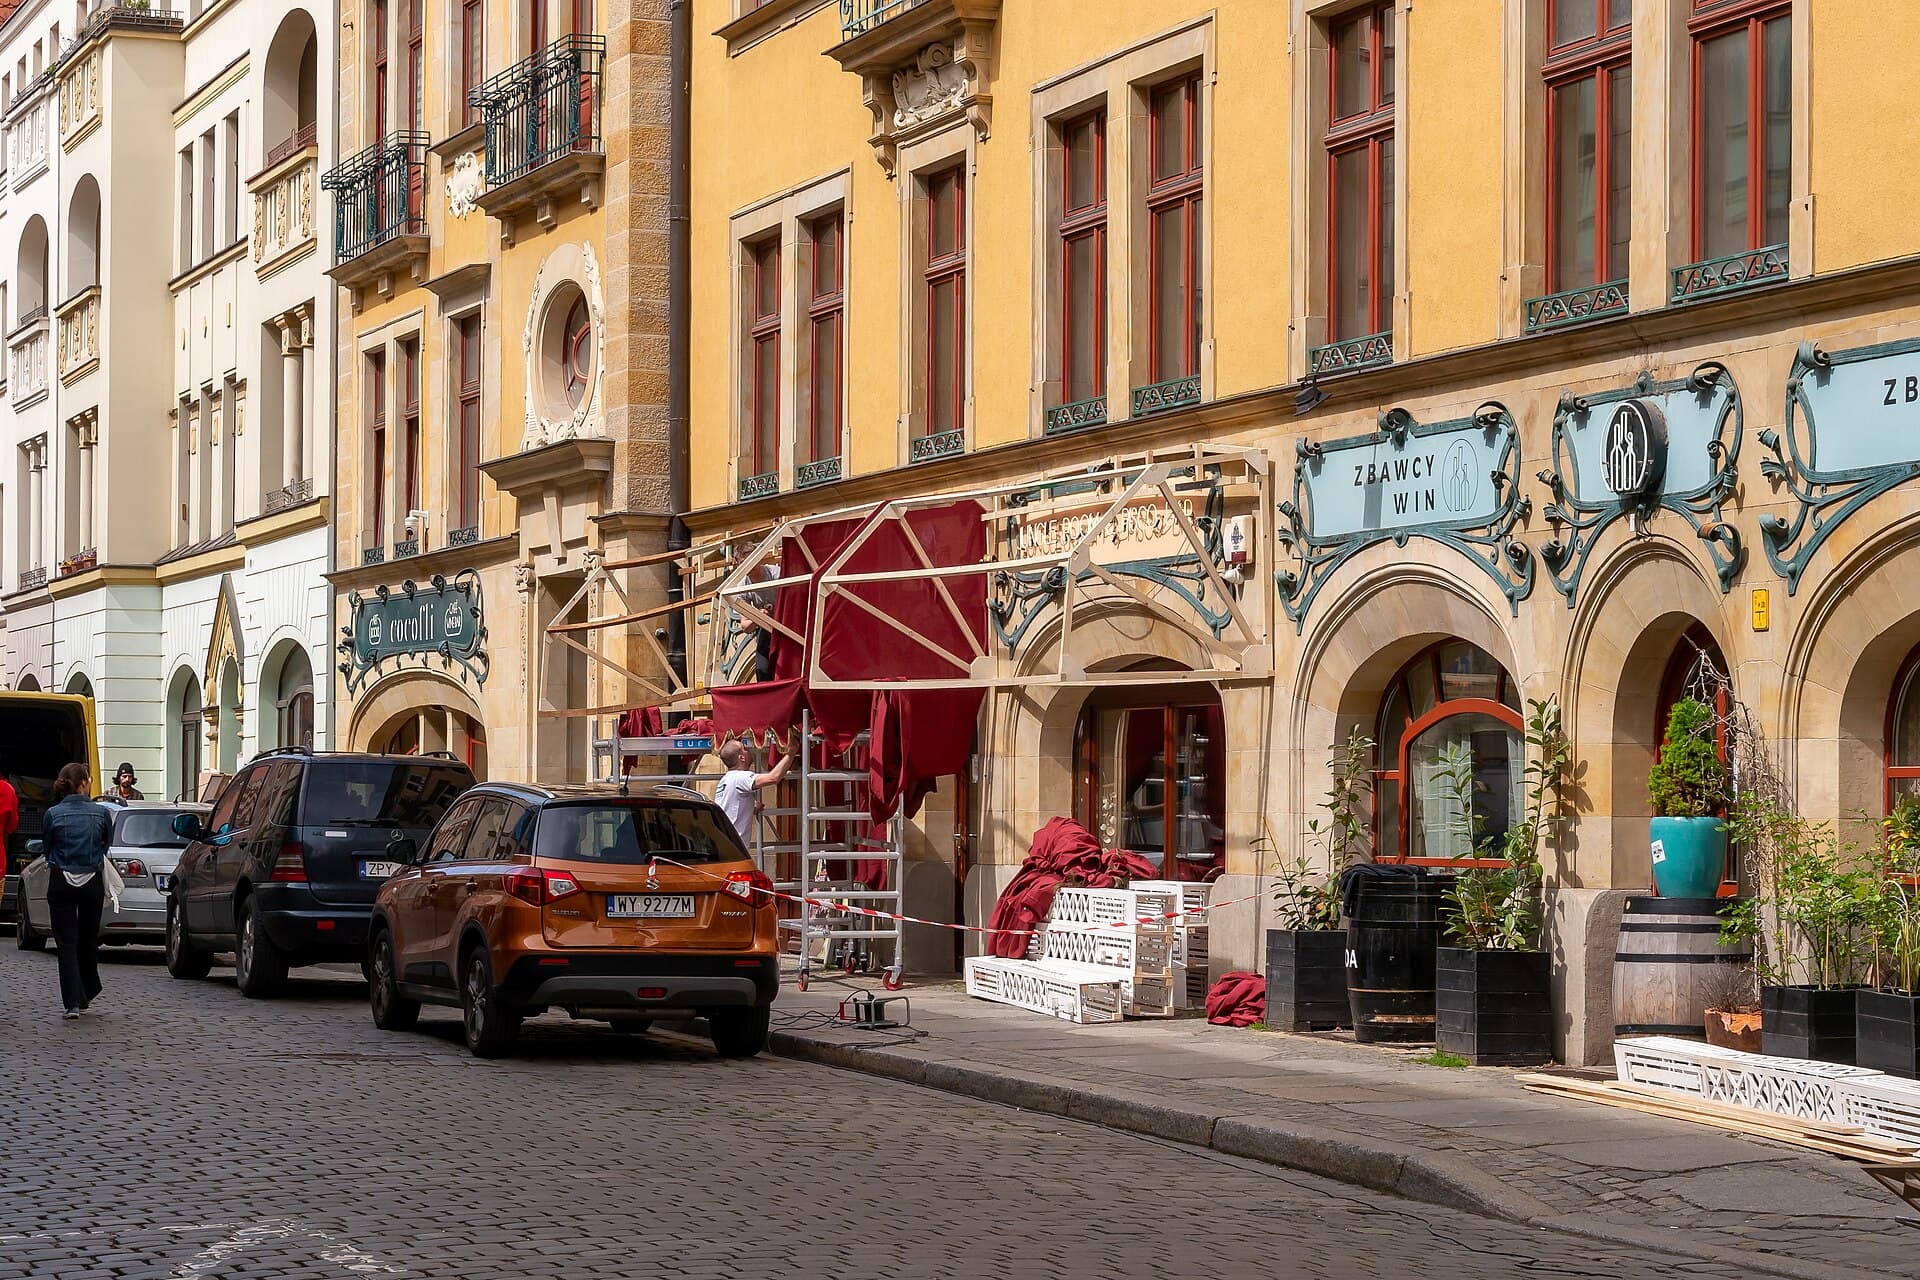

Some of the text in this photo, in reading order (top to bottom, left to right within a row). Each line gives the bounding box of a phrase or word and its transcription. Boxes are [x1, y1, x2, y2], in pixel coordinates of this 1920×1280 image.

[1884, 375, 1919, 405] ZB
[1354, 455, 1435, 487] ZBAWCY
[1393, 489, 1435, 515] WIN
[368, 863, 393, 876] ZPY
[617, 896, 691, 913] WY 9277M
